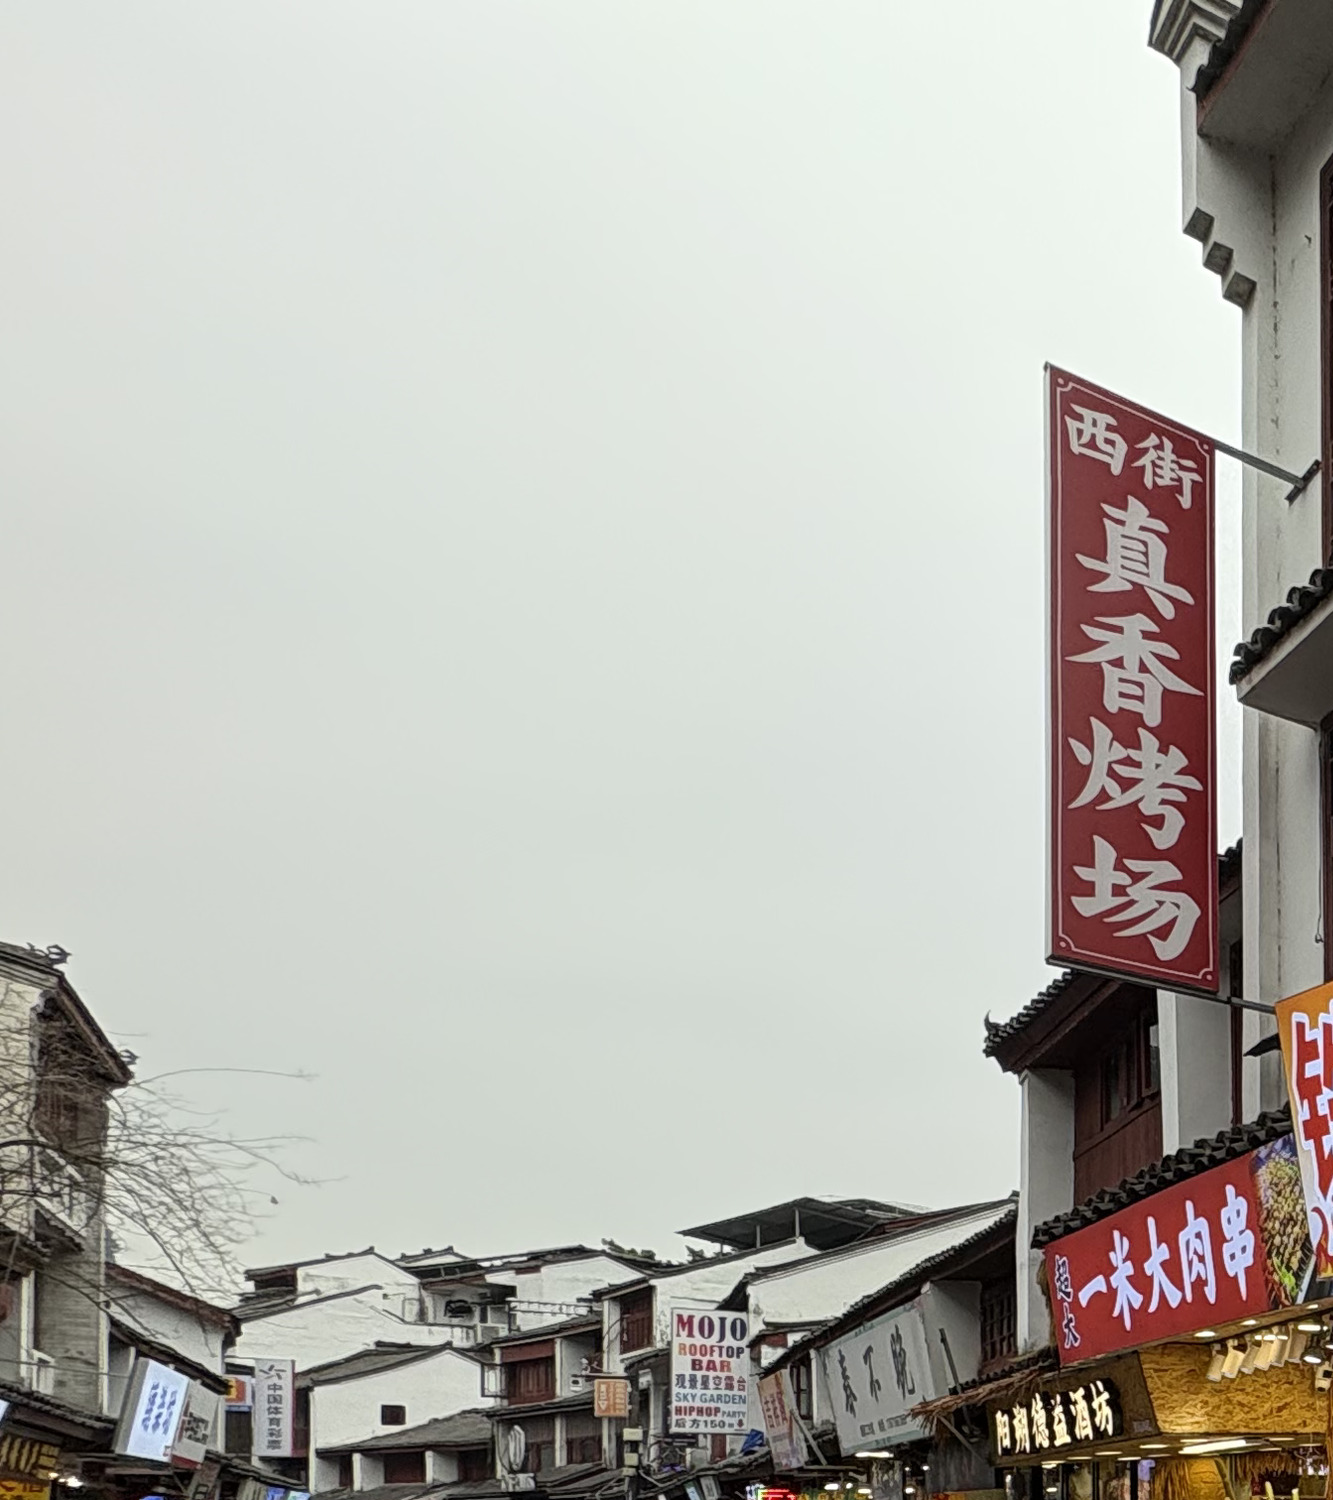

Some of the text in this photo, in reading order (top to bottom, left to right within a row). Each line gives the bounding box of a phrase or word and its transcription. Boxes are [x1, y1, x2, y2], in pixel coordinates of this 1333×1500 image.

[1065, 403, 1204, 510] 西街
[1065, 495, 1206, 963] 真香烤场
[1078, 1184, 1255, 1332] 一米大肉串
[675, 1313, 748, 1343] MOJO
[1054, 1254, 1081, 1350] 超大
[678, 1343, 745, 1359] ROOFTOP
[690, 1358, 732, 1373] BAR
[674, 1391, 747, 1405] SKY GARDEN
[674, 1405, 747, 1419] HIPHOP PARTY
[994, 1380, 1115, 1457] 阳朔德益酒坊
